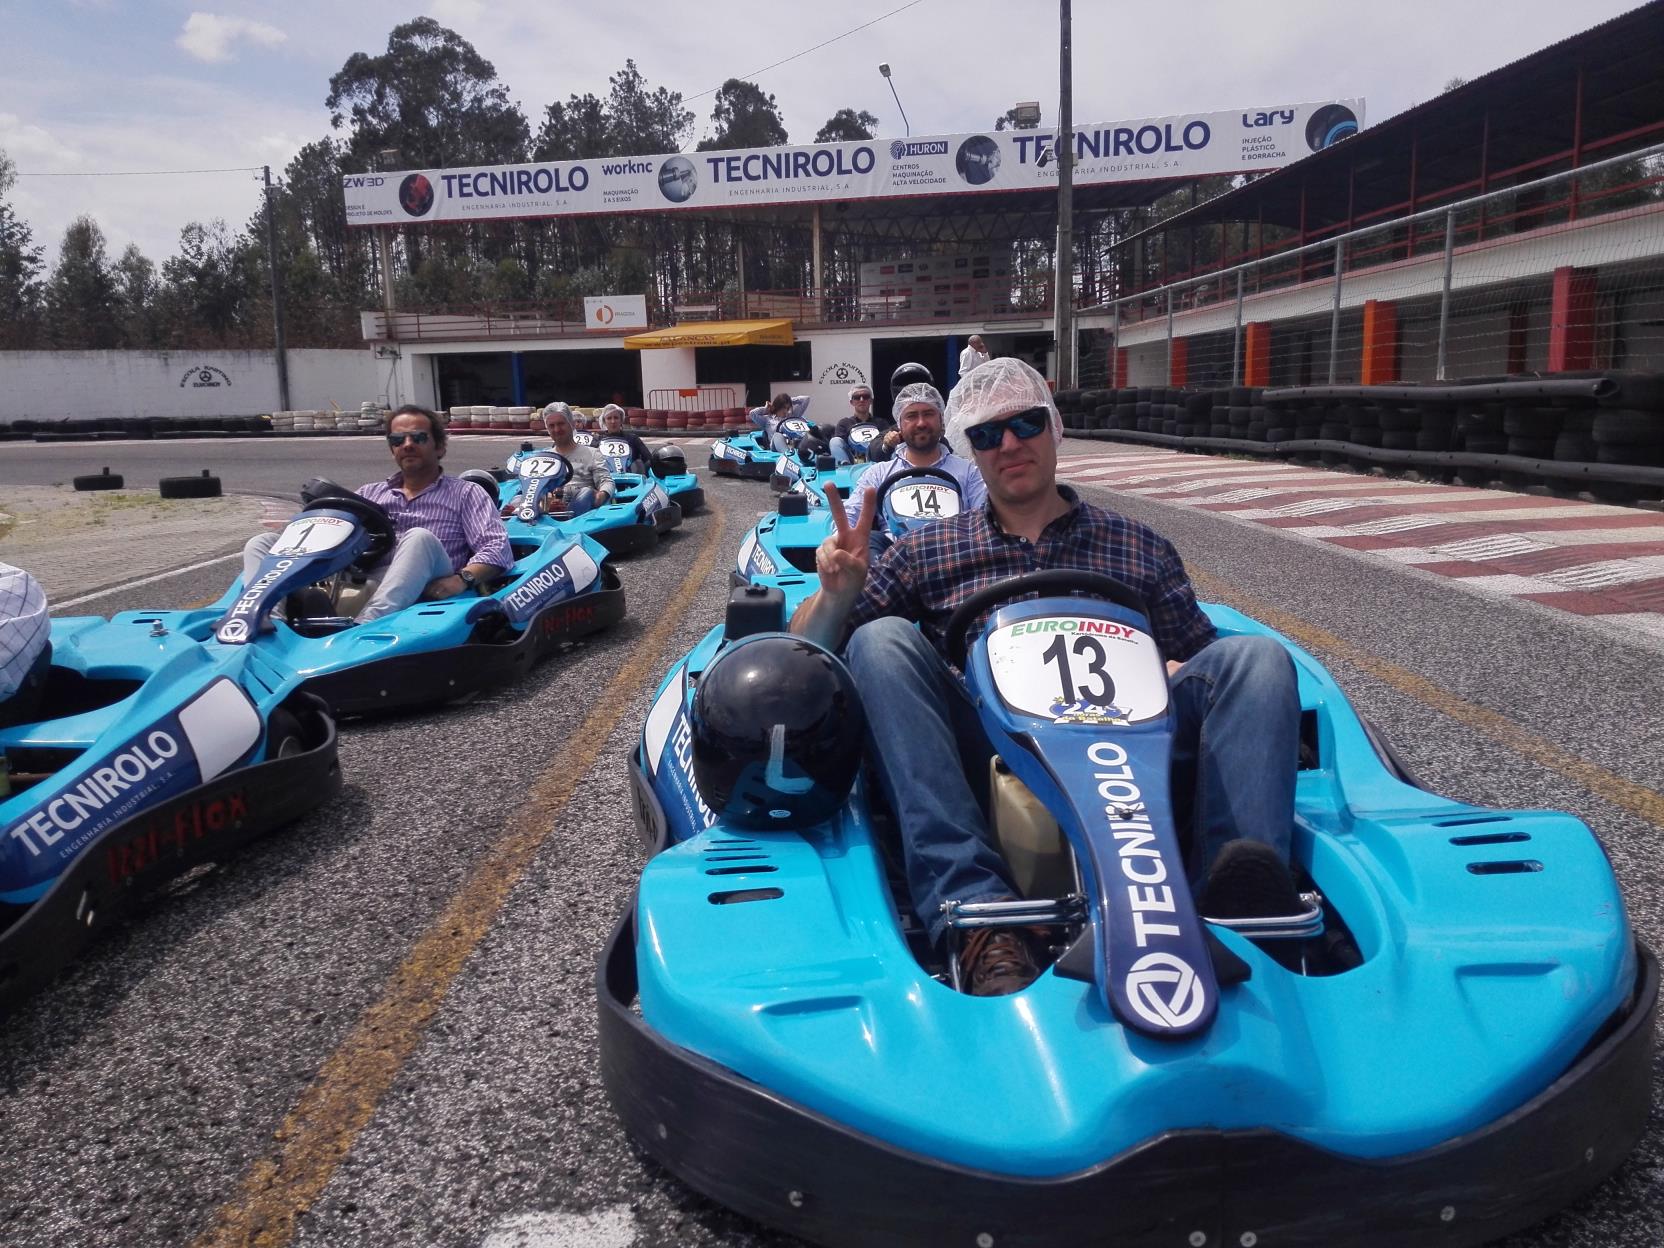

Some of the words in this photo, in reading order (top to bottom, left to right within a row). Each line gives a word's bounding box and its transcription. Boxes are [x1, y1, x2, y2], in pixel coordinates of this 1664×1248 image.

[910, 143, 945, 154] HURON
[1013, 120, 1211, 164] TENIROLO
[707, 146, 875, 183] TECNIROLO
[1248, 152, 1286, 160] BORRACHA
[441, 166, 589, 198] TECNIROLO
[892, 170, 934, 178] MAQUINAÇÃO
[1037, 167, 1096, 178] ENGEARIA
[792, 422, 806, 430] 31
[862, 430, 872, 438] 5
[576, 436, 590, 444] 29
[609, 444, 625, 454] 28
[530, 460, 556, 474] 27
[911, 490, 941, 514] 14
[292, 524, 316, 550] 1
[231, 559, 294, 618] TECNIROLO
[506, 563, 565, 612] TECNIROLO
[1010, 619, 1136, 639] EUROINDY
[1042, 634, 1117, 707] 13
[10, 730, 178, 857] TECNIROLO
[60, 817, 113, 859] ENGENHARIA
[1087, 742, 1181, 948] TECNIROLO
